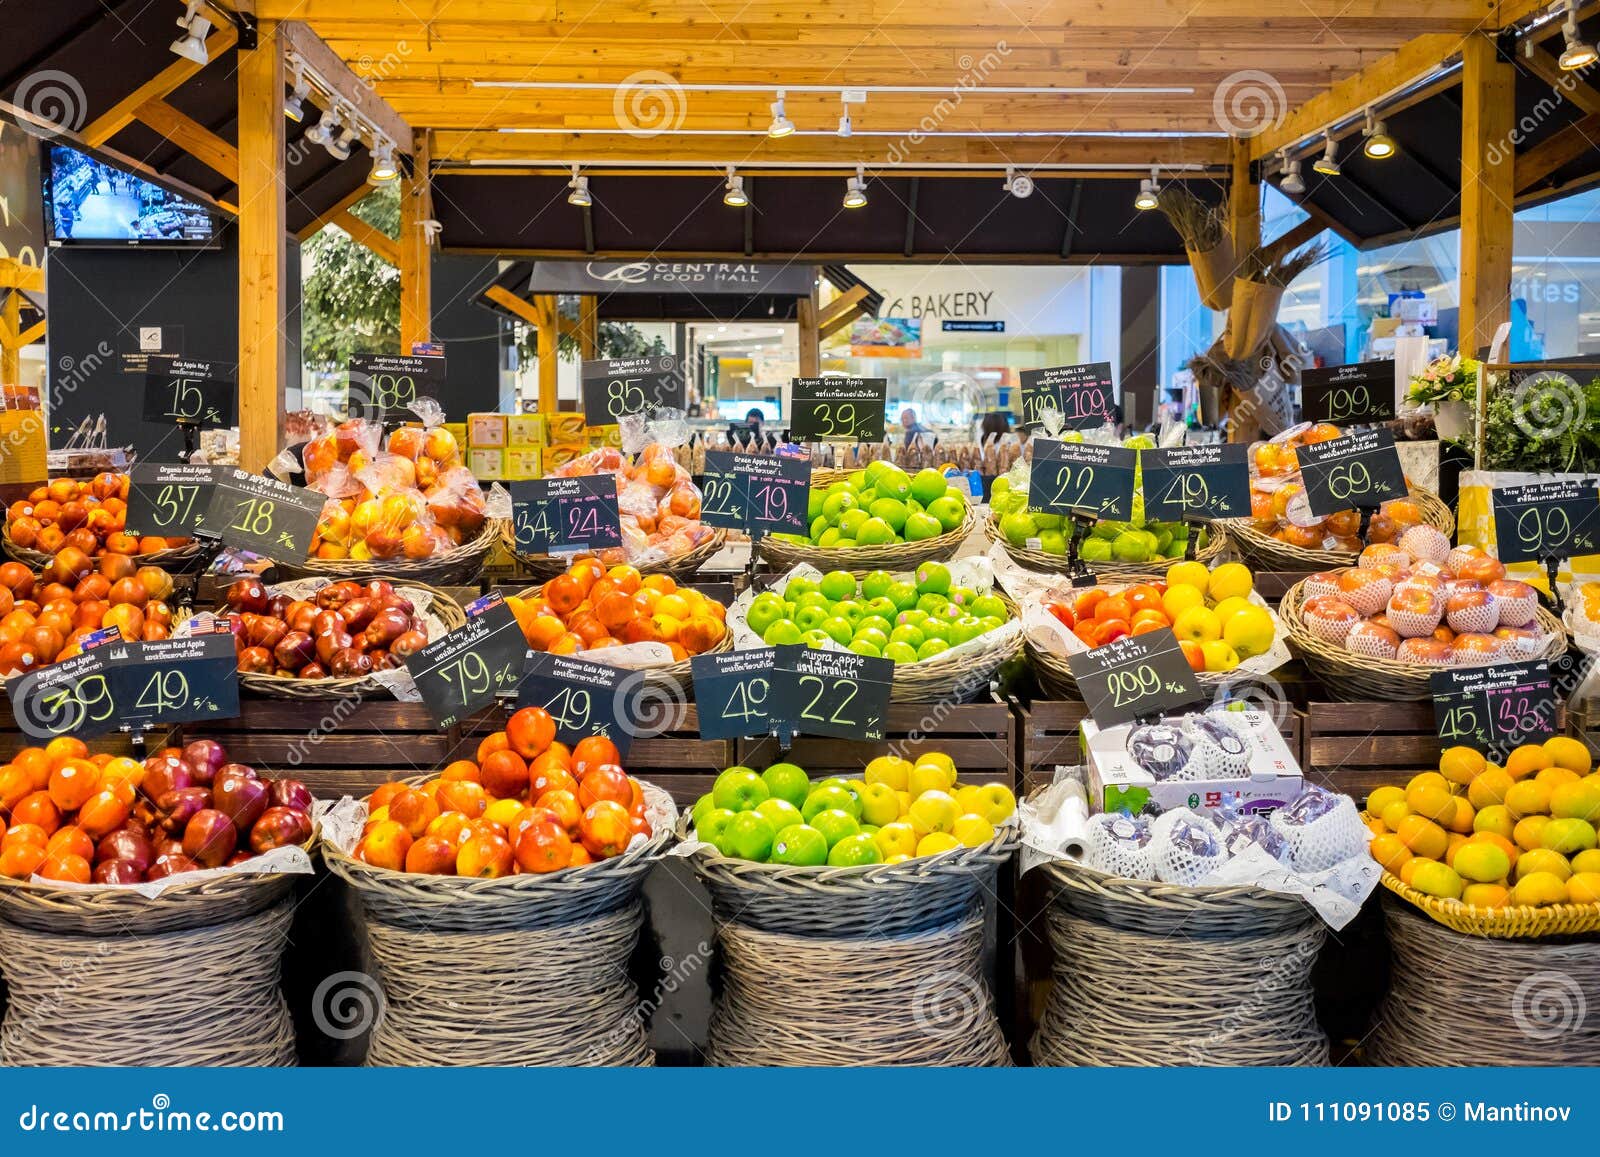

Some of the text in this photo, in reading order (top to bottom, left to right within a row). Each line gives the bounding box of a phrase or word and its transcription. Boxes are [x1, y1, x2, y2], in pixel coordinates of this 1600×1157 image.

[653, 273, 758, 282] FOOD HALL
[655, 263, 759, 274] CENTRAL
[911, 291, 994, 319] BAKERY
[164, 379, 202, 418] 15
[608, 379, 645, 416] 85
[798, 379, 820, 389] Organic
[824, 378, 843, 386] Green
[813, 403, 855, 436] 39
[1318, 385, 1370, 422] 199
[734, 455, 752, 464] Green
[752, 457, 768, 467] Apple
[1094, 447, 1110, 456] Apple
[1167, 447, 1222, 458] Premium Red Apple
[159, 466, 182, 474] Organic
[195, 467, 212, 476] Apple
[232, 469, 249, 480] RED
[248, 475, 274, 487] APPLE
[548, 479, 579, 489] Envy Apple
[1328, 462, 1370, 498] 69
[755, 485, 787, 521] 19
[1050, 466, 1099, 510] 22
[1163, 473, 1209, 510] 49
[152, 485, 200, 526] 37
[231, 498, 275, 535] 18
[515, 510, 551, 544] 34
[568, 507, 604, 539] 24
[1518, 507, 1570, 553] 99
[142, 643, 172, 651] Premium
[187, 640, 205, 650] Apple
[447, 631, 464, 643] Envy
[466, 617, 486, 632] Apple
[37, 654, 96, 679] Organic Gala Apple
[554, 658, 615, 678] Premium Gala Apple
[715, 654, 744, 664] Premium
[744, 652, 764, 661] Green
[838, 655, 864, 670] Apple
[1086, 648, 1110, 659] Grape
[135, 671, 189, 713] 49
[438, 652, 490, 706] 79
[1107, 665, 1161, 707] 299
[1452, 672, 1484, 682] Korean
[42, 674, 114, 733] 39
[543, 687, 591, 731] 49
[799, 675, 859, 725] 22
[1439, 705, 1476, 740] 45
